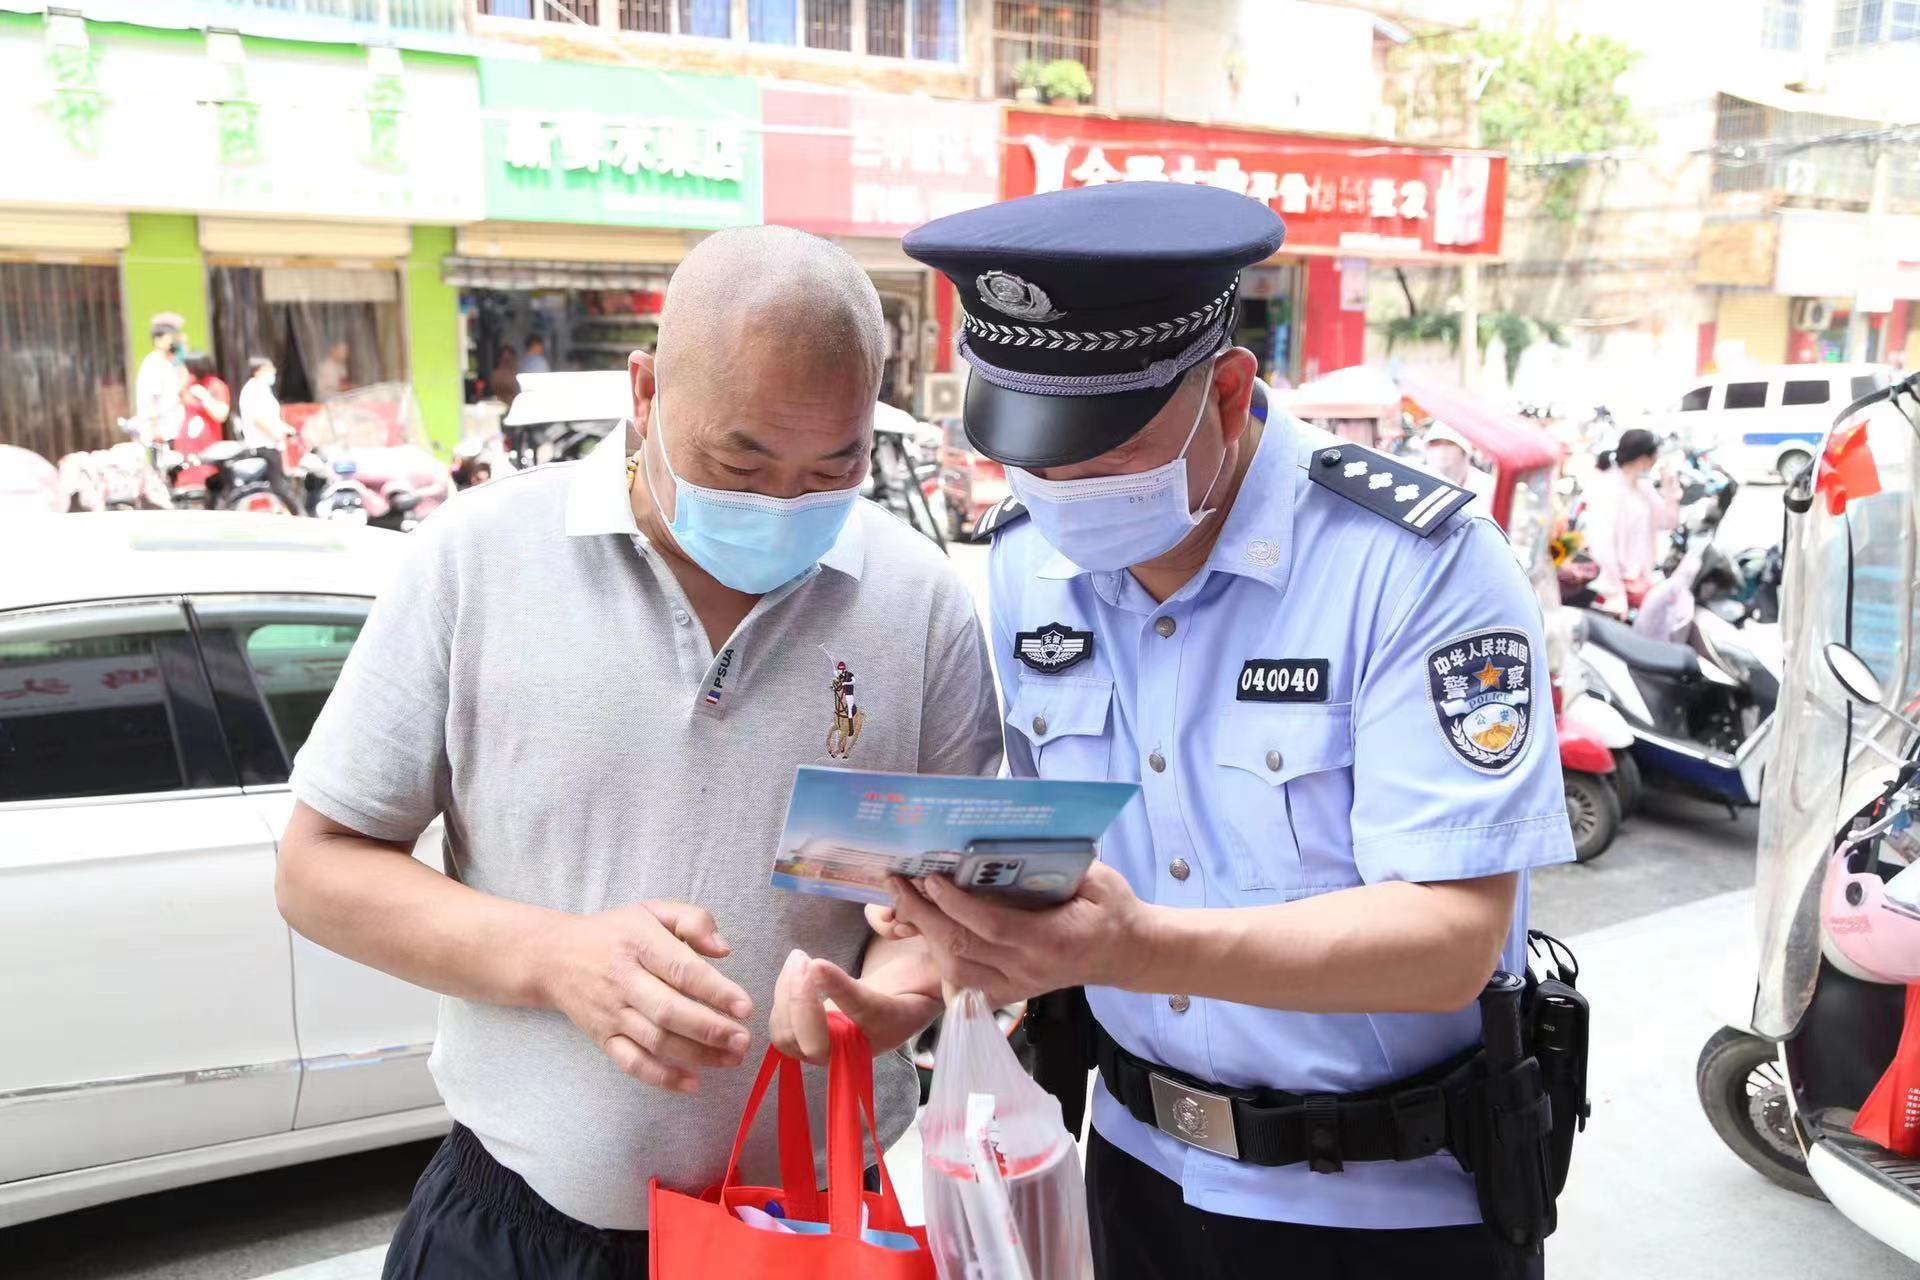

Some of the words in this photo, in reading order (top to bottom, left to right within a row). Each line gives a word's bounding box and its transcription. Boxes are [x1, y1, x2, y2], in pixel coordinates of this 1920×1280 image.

[714, 649, 734, 688] PSUA
[1433, 638, 1528, 675] 中华人民共和国
[1241, 667, 1319, 692] 040040
[1469, 692, 1510, 709] POLICE
